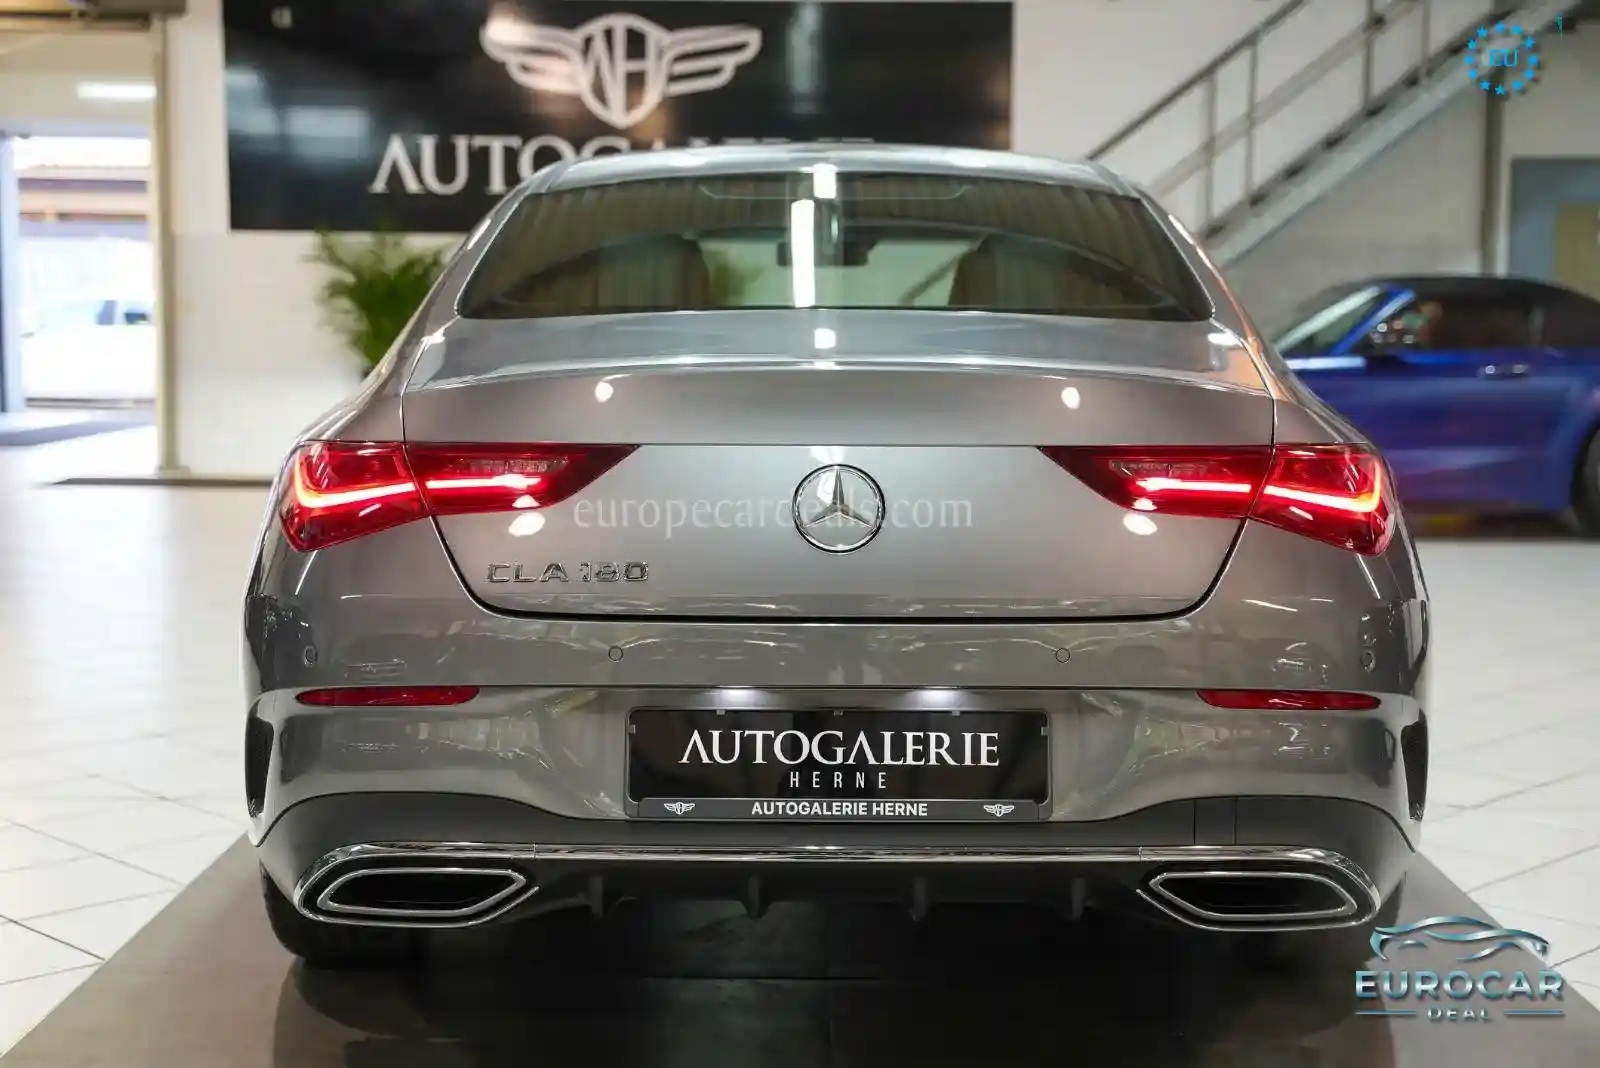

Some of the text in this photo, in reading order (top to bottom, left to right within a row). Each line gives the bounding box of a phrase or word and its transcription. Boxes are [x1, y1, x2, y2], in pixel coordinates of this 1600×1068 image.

[487, 561, 649, 583] CLA 180
[679, 729, 1000, 766] AUTOGALERIE
[790, 771, 888, 790] HERNE
[751, 802, 928, 817] AUTOGALERIE HERNE
